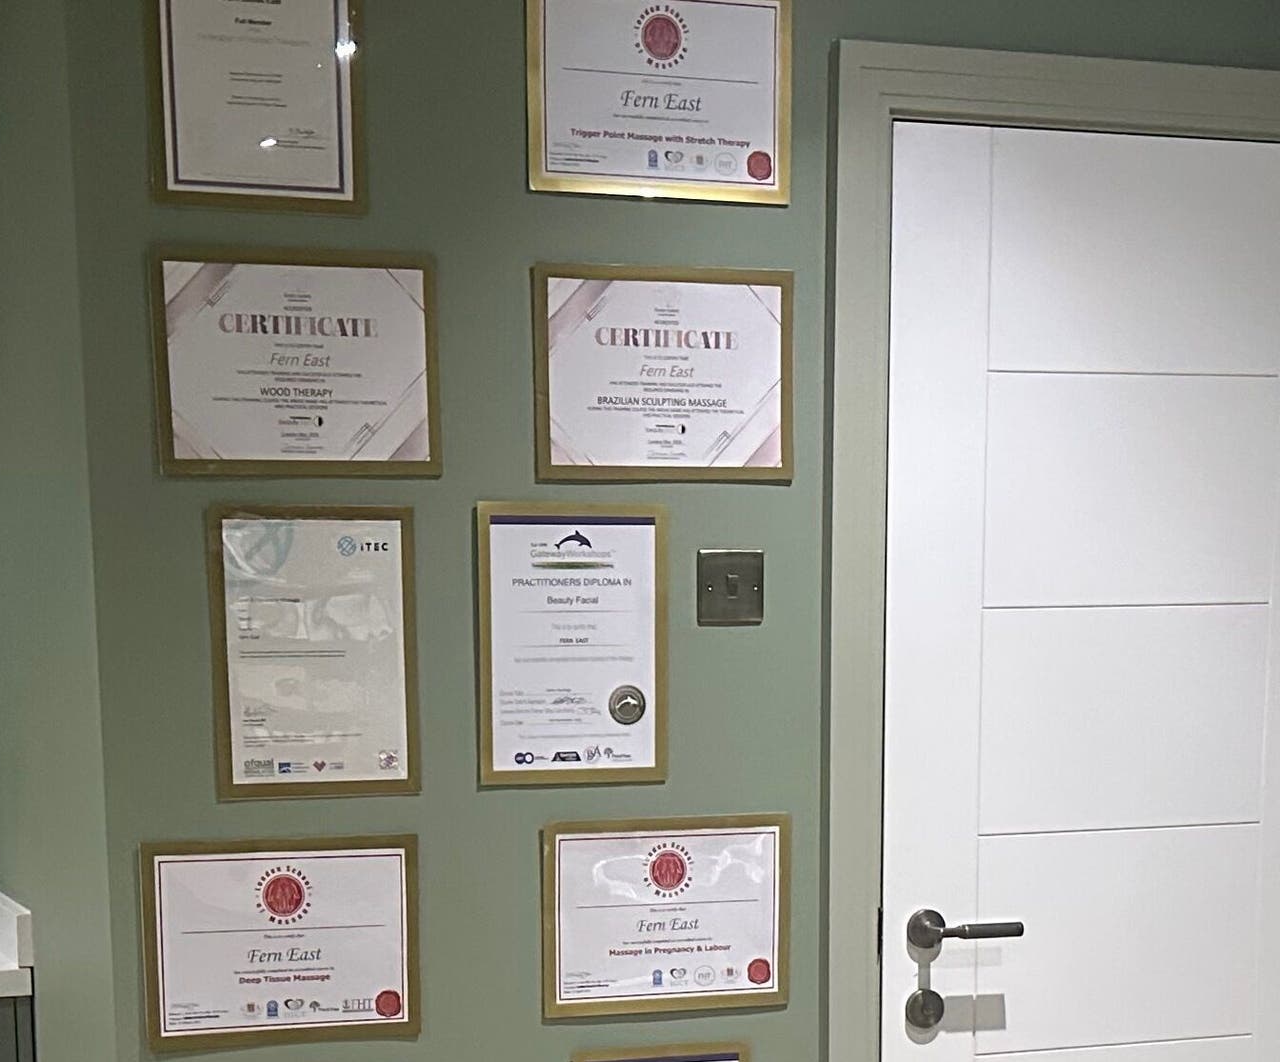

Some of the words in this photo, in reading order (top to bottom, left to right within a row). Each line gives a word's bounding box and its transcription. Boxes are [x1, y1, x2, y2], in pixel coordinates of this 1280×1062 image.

[620, 89, 659, 110] Fern
[663, 92, 702, 112] East
[570, 128, 601, 139] Trigger
[603, 130, 625, 140] Point
[627, 132, 663, 143] Massage
[665, 133, 683, 144] with
[685, 135, 715, 146] Stretch
[717, 137, 751, 149] Therapy
[219, 312, 379, 338] CERTIFICATE
[594, 327, 739, 350] CERTIFICATE
[270, 352, 300, 367] Fern
[303, 353, 331, 368] East
[640, 364, 666, 378] Fern
[669, 365, 695, 378] East
[260, 387, 291, 397] WOOD
[292, 388, 333, 398] THERAPY
[597, 396, 640, 406] BRAZILIAN
[641, 397, 687, 408] SCULPTING
[688, 398, 728, 409] MASSAGE
[512, 578, 582, 587] PRACTITIONERS
[583, 578, 622, 587] DIPLOMA
[623, 578, 632, 587] IN
[546, 595, 574, 606] Beauty
[575, 595, 600, 605] Facial
[636, 919, 666, 933] Fern
[670, 918, 700, 932] East
[247, 948, 283, 964] Fern
[285, 947, 322, 963] East
[609, 947, 643, 958] Massage
[644, 947, 652, 955] in
[654, 946, 695, 957] Pregnancy
[696, 944, 703, 952] &
[704, 943, 731, 952] Labour
[239, 975, 262, 985] Deep
[263, 974, 291, 984] Tissue
[293, 973, 331, 984] Massage
